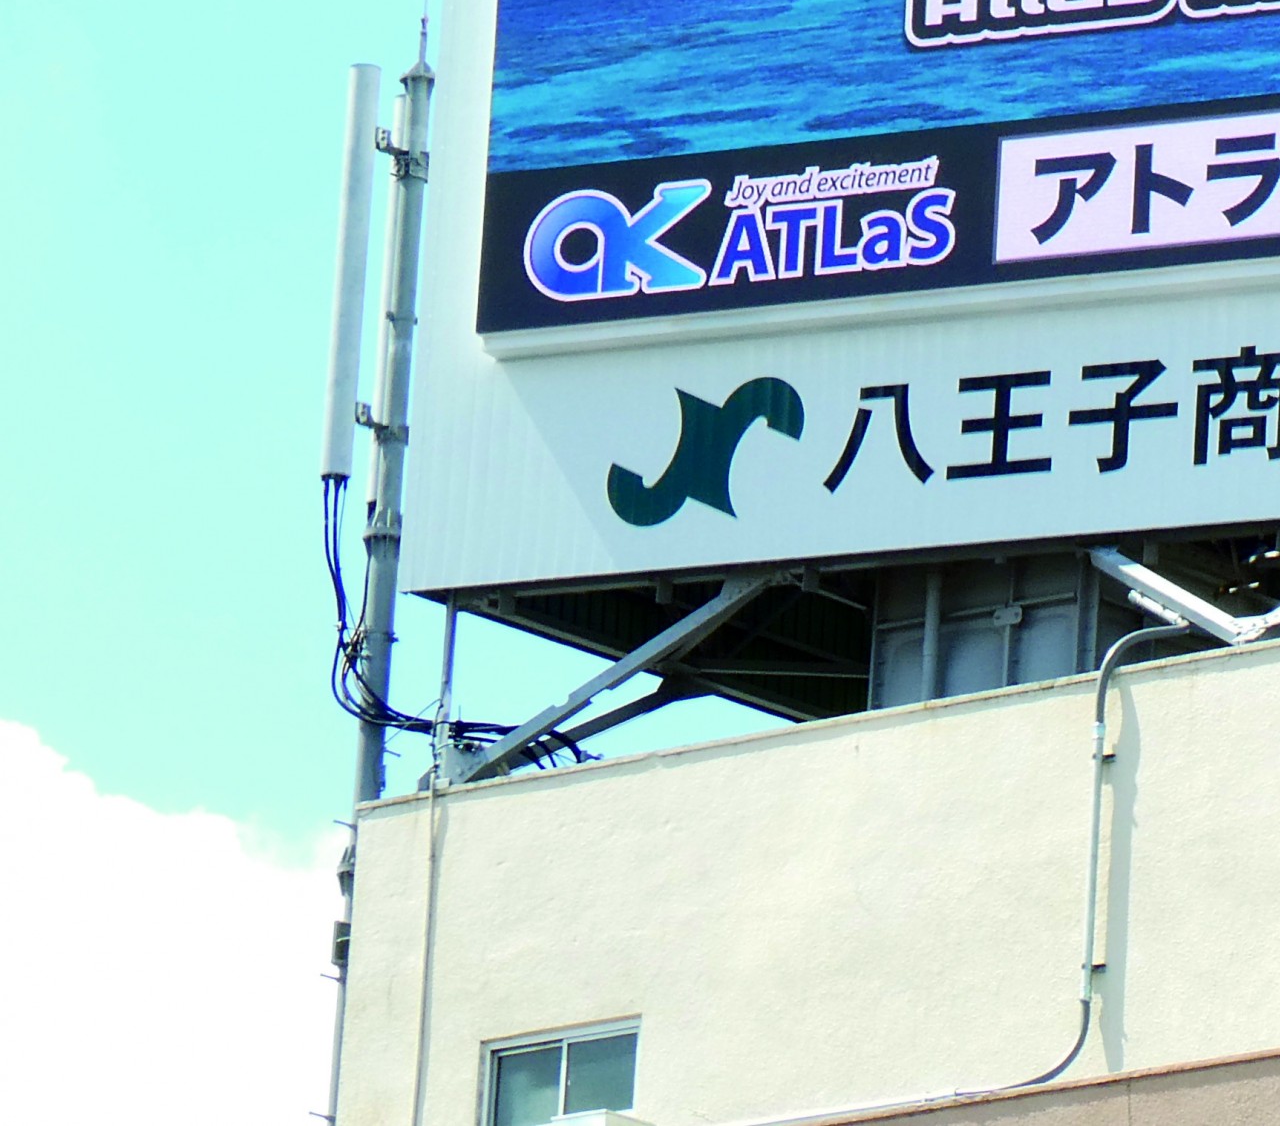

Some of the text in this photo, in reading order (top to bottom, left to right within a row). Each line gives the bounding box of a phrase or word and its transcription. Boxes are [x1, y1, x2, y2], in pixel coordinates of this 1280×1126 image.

[727, 160, 932, 206] Joy and excitement
